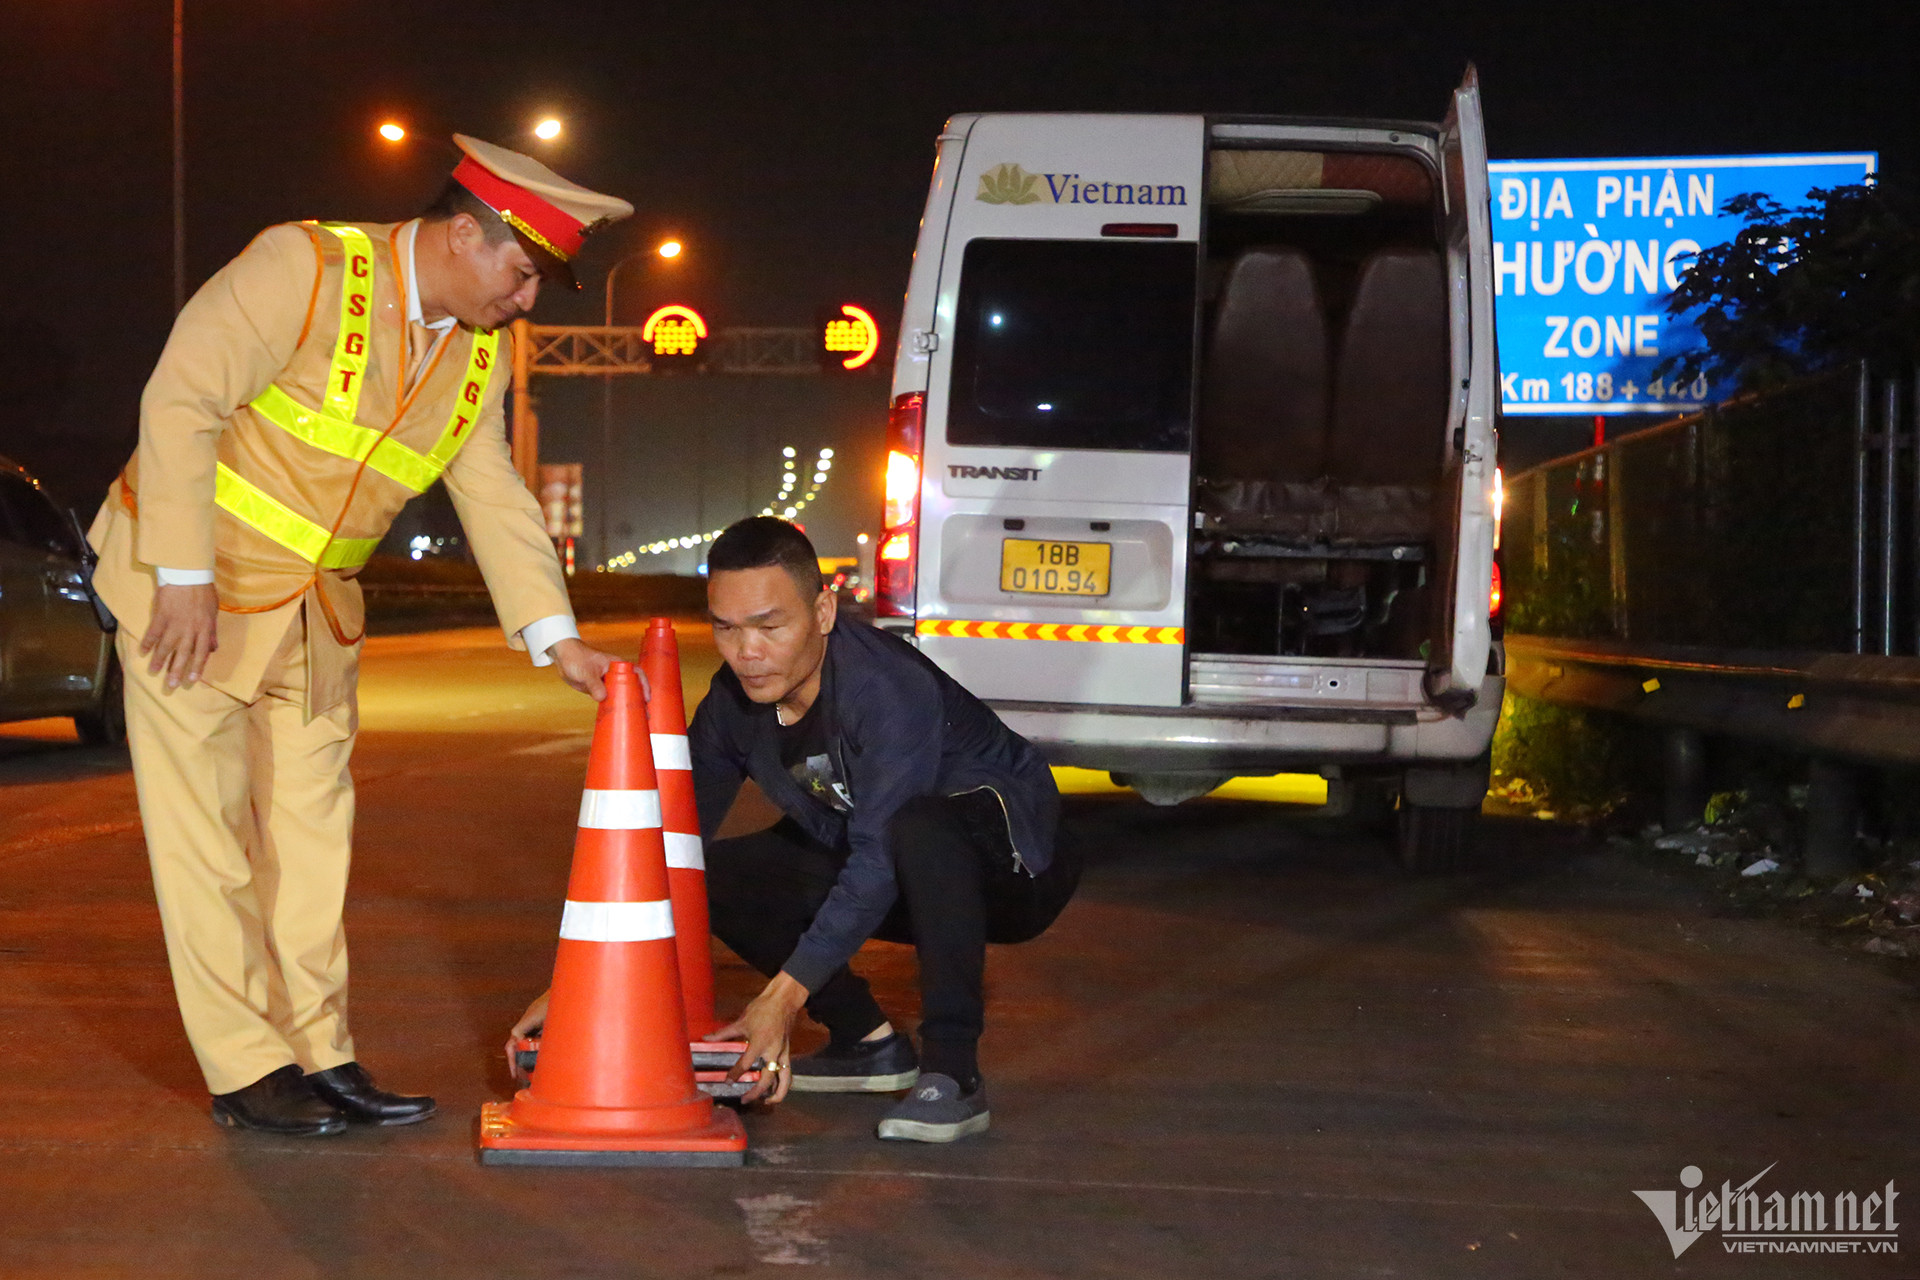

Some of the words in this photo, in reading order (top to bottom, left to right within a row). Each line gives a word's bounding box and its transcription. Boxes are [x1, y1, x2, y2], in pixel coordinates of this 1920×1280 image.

[1043, 173, 1188, 206] Vietnam
[1498, 177, 1574, 231] ĐỊA
[1596, 168, 1715, 228] PHẬN
[338, 254, 369, 394] CSGT
[1543, 315, 1660, 358] ZONE
[450, 325, 495, 438] SGT
[1500, 371, 1550, 402] Km
[1560, 371, 1614, 402] 188
[947, 464, 1042, 482] TRANSIT
[1036, 543, 1080, 567] 18B
[1012, 567, 1096, 593] 010.94
